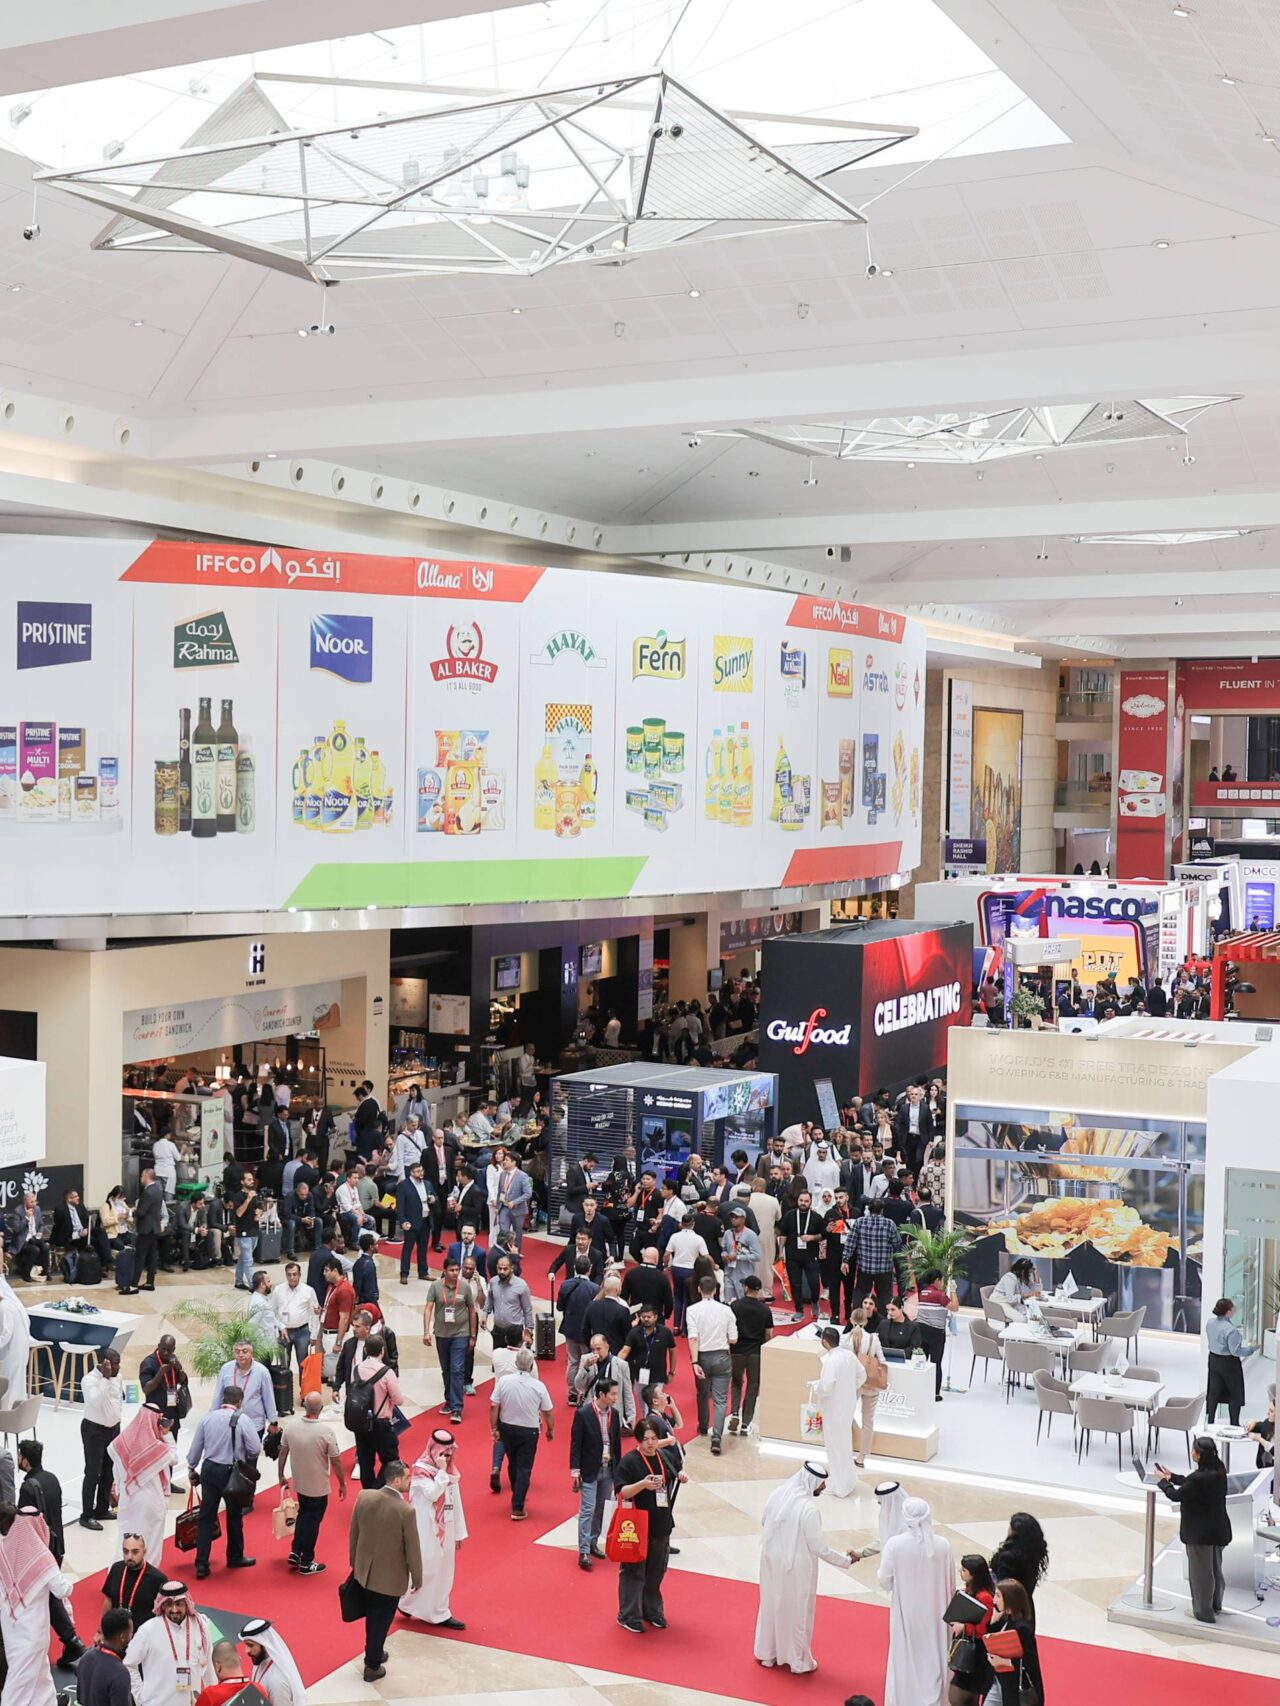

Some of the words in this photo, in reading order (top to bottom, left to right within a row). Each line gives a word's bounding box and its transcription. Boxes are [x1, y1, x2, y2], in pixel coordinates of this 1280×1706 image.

[196, 554, 256, 574] IFFCO
[417, 561, 461, 589] Allana
[812, 605, 832, 621] IFFCO
[22, 621, 87, 646] PRISTINE
[316, 632, 369, 657] NOOR
[545, 632, 595, 662] HAYAT
[639, 644, 681, 672] Fern
[714, 649, 753, 685] Sunny
[437, 662, 452, 678] AL
[456, 662, 493, 679] BAKER
[831, 662, 850, 686] Nabil
[458, 681, 468, 690] ALL
[1220, 680, 1262, 689] FLUENT
[1264, 680, 1275, 688] IN
[25, 728, 51, 737] PRISTINE
[555, 717, 585, 735] HAYAT
[27, 756, 50, 765] MULTI
[324, 798, 350, 807] NOOR
[1181, 873, 1212, 881] DMCC
[1243, 867, 1277, 876] DMCC
[1046, 895, 1141, 919] nasco
[1082, 950, 1124, 967] POT
[263, 1005, 288, 1017] Gourmet
[874, 981, 961, 1036] CELEBRATING
[141, 1014, 157, 1026] BUILD
[158, 1011, 172, 1022] YOUR
[173, 1010, 185, 1021] OWN
[262, 1018, 285, 1031] SANDWICH
[133, 1024, 163, 1041] Gourmet
[165, 1022, 192, 1036] SANDWICH
[766, 1008, 851, 1055] Gulfood
[989, 1054, 1054, 1068] WORLD'S
[1079, 1059, 1116, 1071] FREE
[1118, 1061, 1170, 1075] TRADE
[1172, 1065, 1214, 1077] ZONE
[989, 1068, 1047, 1079] POWERING
[1048, 1071, 1070, 1081] F&B
[1071, 1073, 1165, 1087] MANUFACTURING
[1167, 1079, 1174, 1087] &
[1177, 1079, 1206, 1090] TRAD
